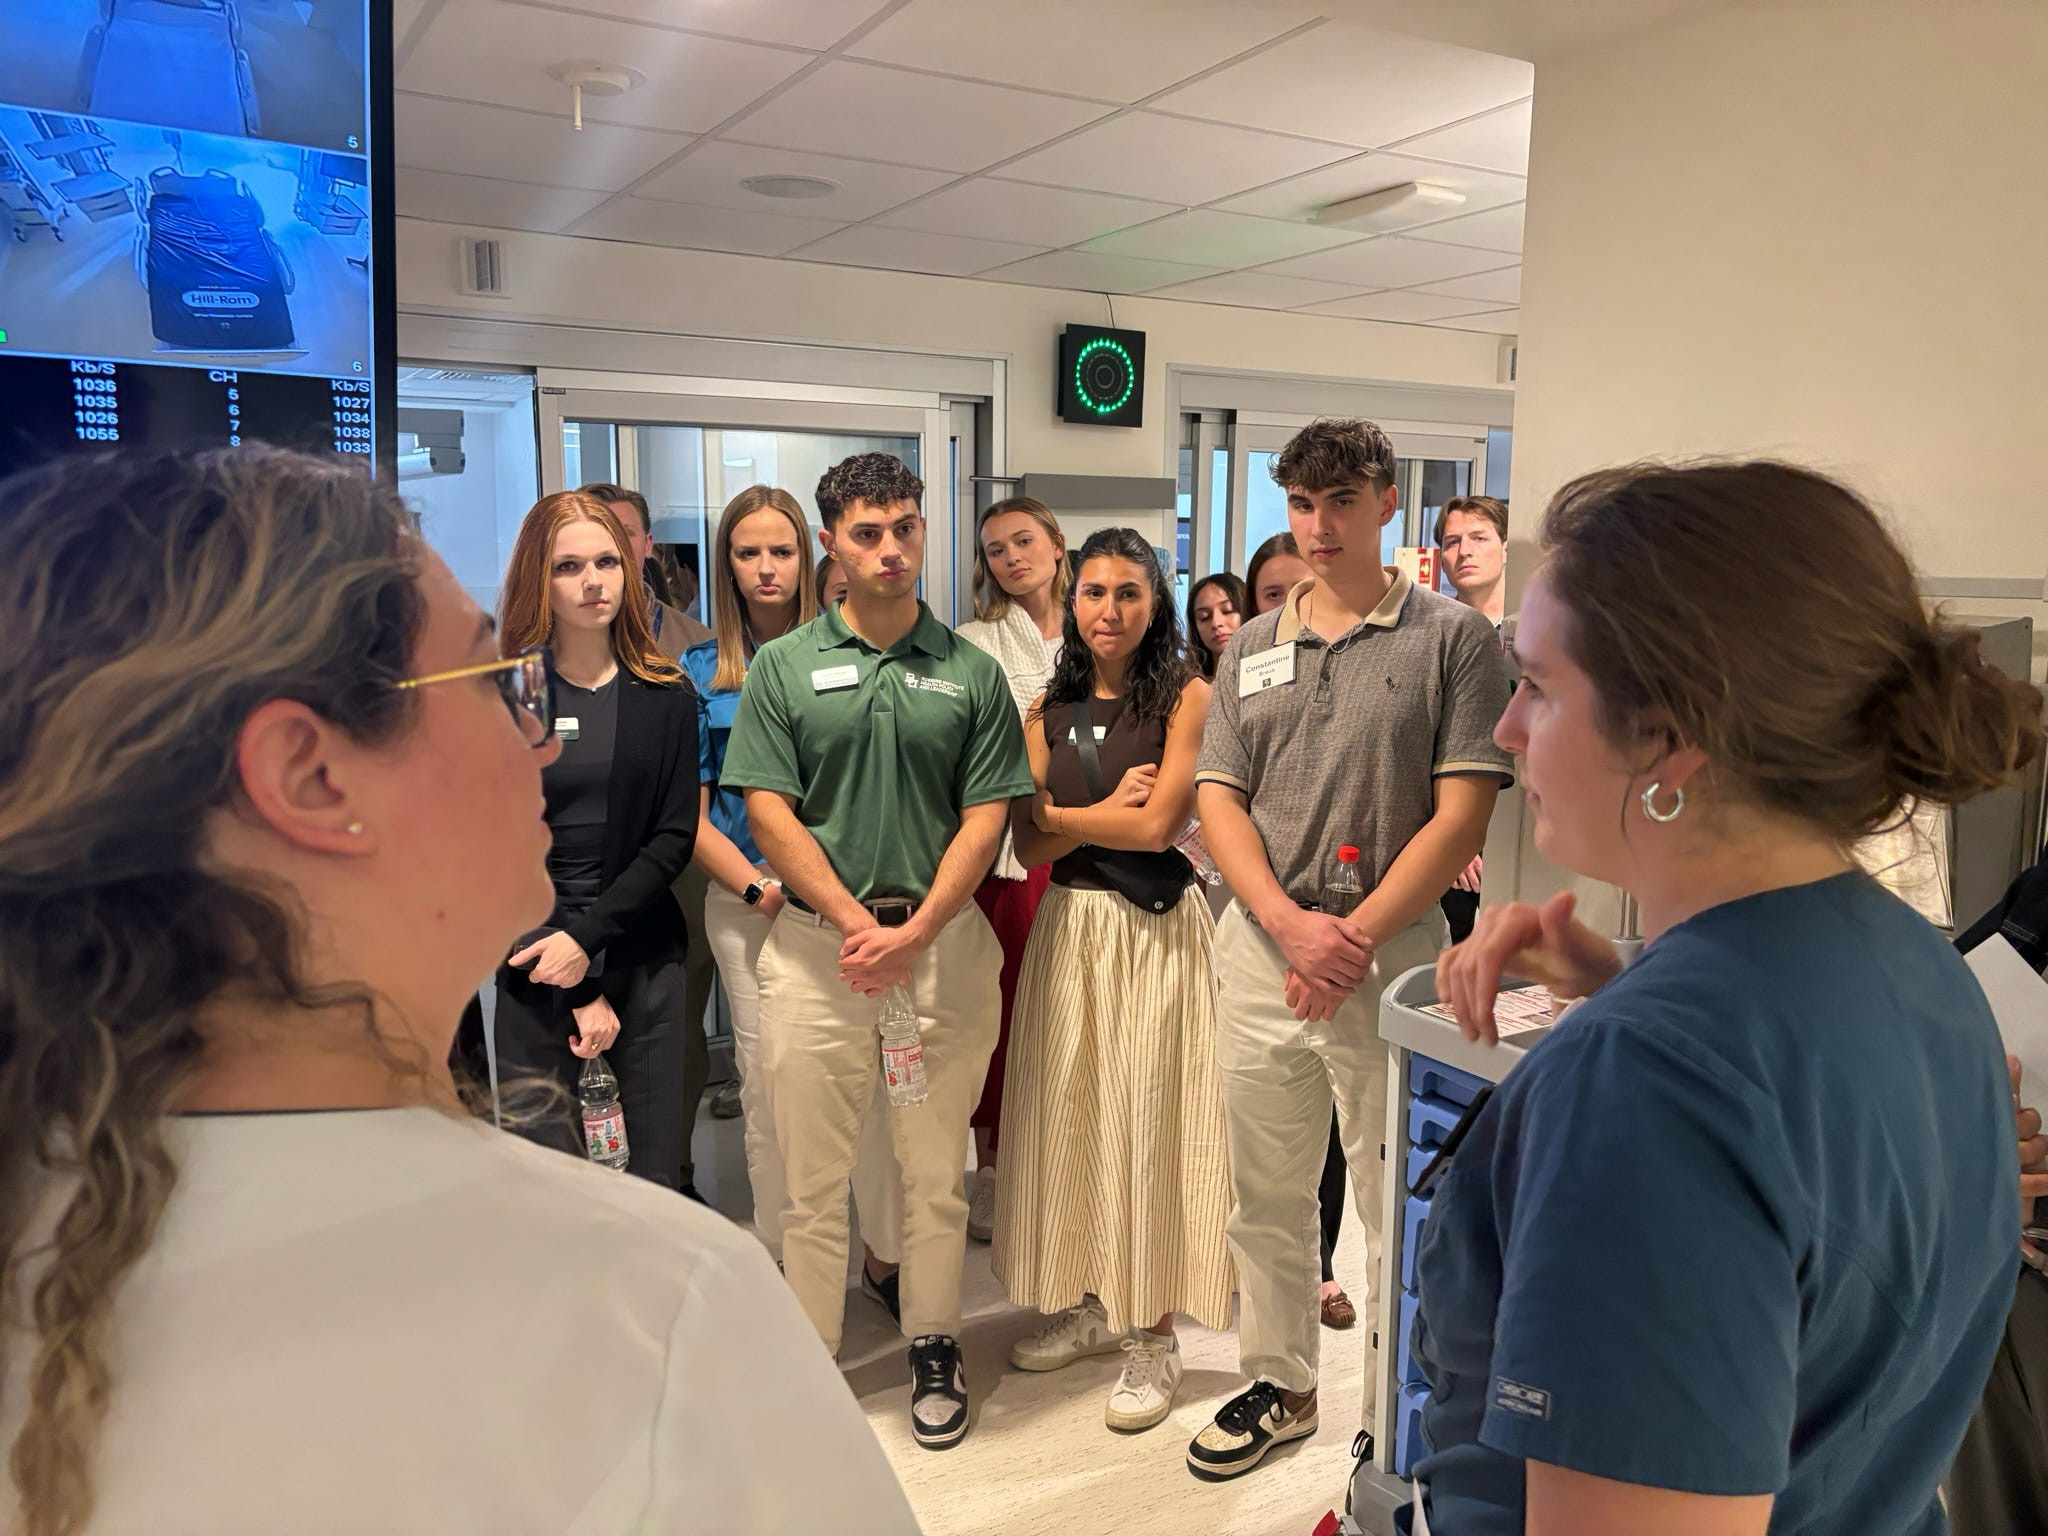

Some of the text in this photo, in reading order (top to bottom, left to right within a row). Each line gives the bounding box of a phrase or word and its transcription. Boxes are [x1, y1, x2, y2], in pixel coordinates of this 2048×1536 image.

[347, 135, 358, 149] 5
[190, 294, 252, 305] Hill-Rom
[71, 360, 370, 393] Kb/S CH Kb/S
[352, 361, 362, 372] 6
[73, 377, 370, 409] 1036 5 1027
[74, 393, 370, 424] 1035 6 1034
[74, 410, 371, 439] 1026 7 1038
[75, 426, 371, 454] 1055 8 1033
[1245, 655, 1290, 673] Constantine
